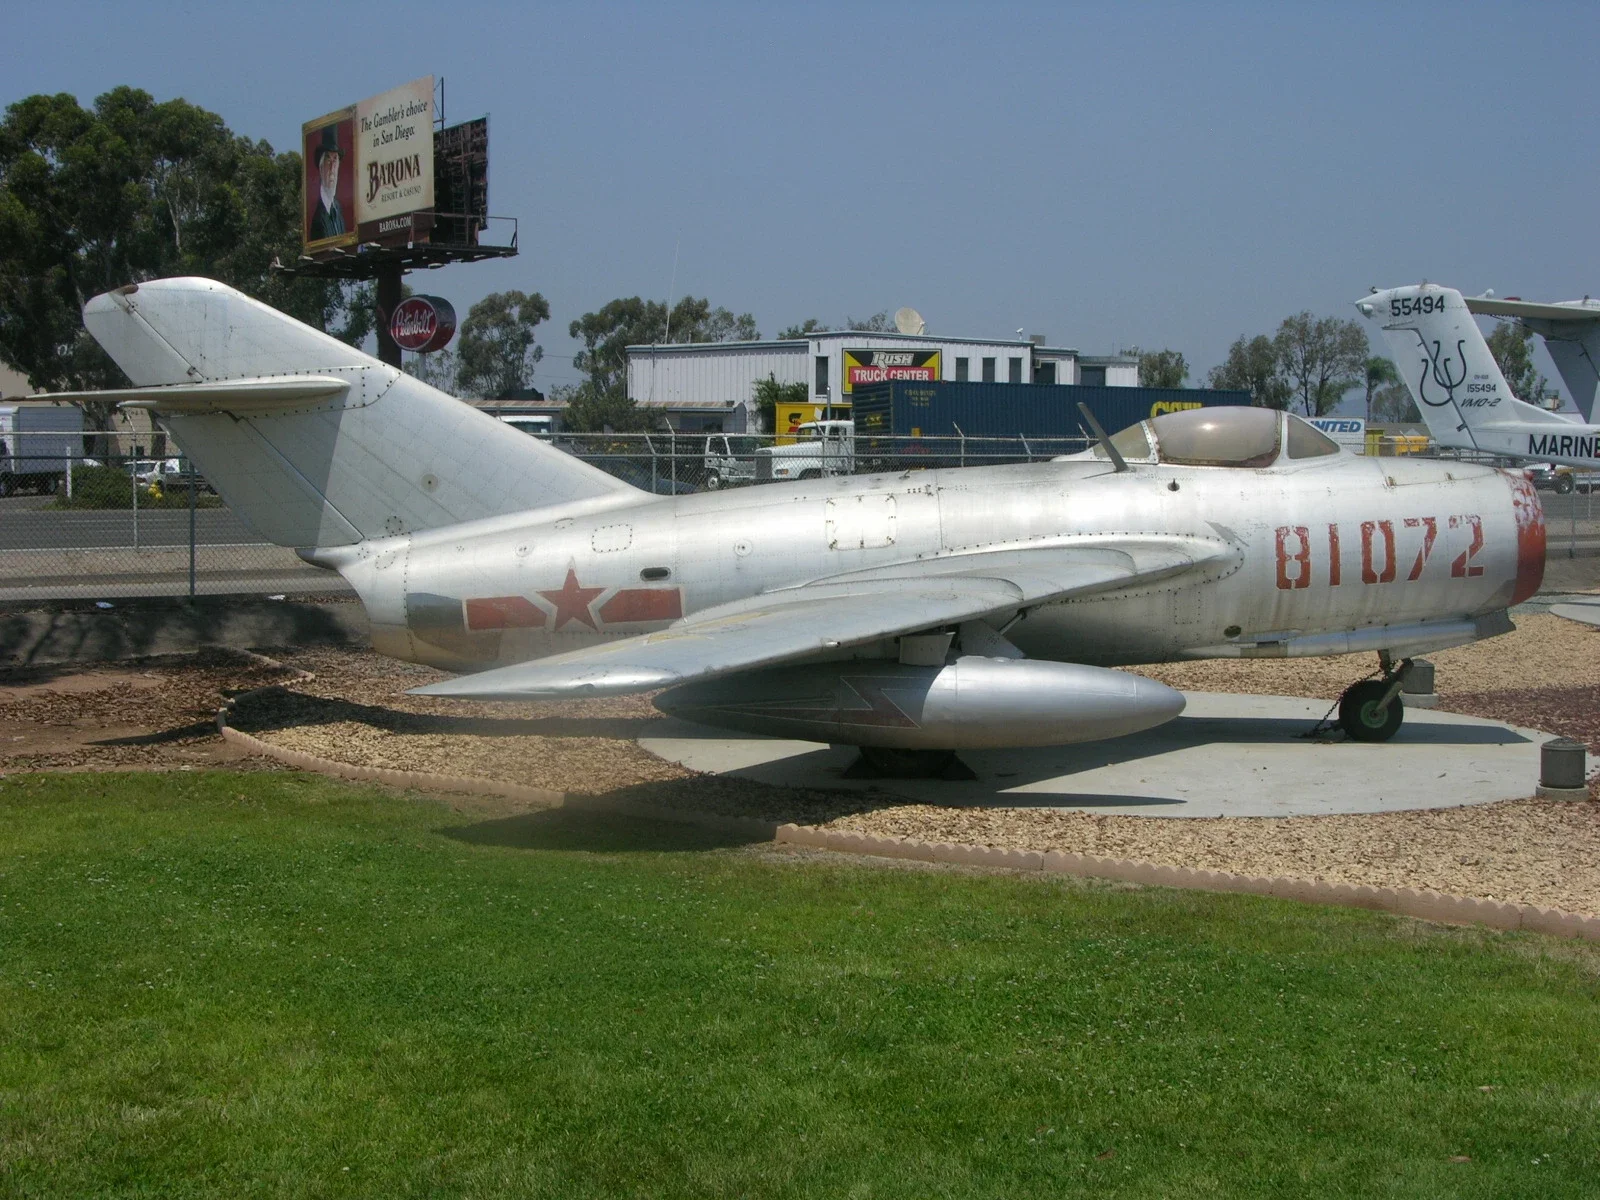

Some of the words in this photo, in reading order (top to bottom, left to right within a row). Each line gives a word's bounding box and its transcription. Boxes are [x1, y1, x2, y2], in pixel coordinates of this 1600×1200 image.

[361, 116, 372, 133] The
[373, 104, 404, 128] Gambler's
[406, 99, 428, 117] choice
[373, 133, 380, 148] in
[381, 130, 393, 145] San
[366, 153, 421, 203] BARONA
[379, 216, 412, 233] BARONA.COM
[1391, 295, 1445, 317] 55494
[854, 369, 888, 382] TRUCK
[890, 369, 930, 381] CENTER
[1467, 383, 1497, 393] 155494
[1310, 420, 1362, 433] NITED
[1274, 514, 1485, 590] 81072
